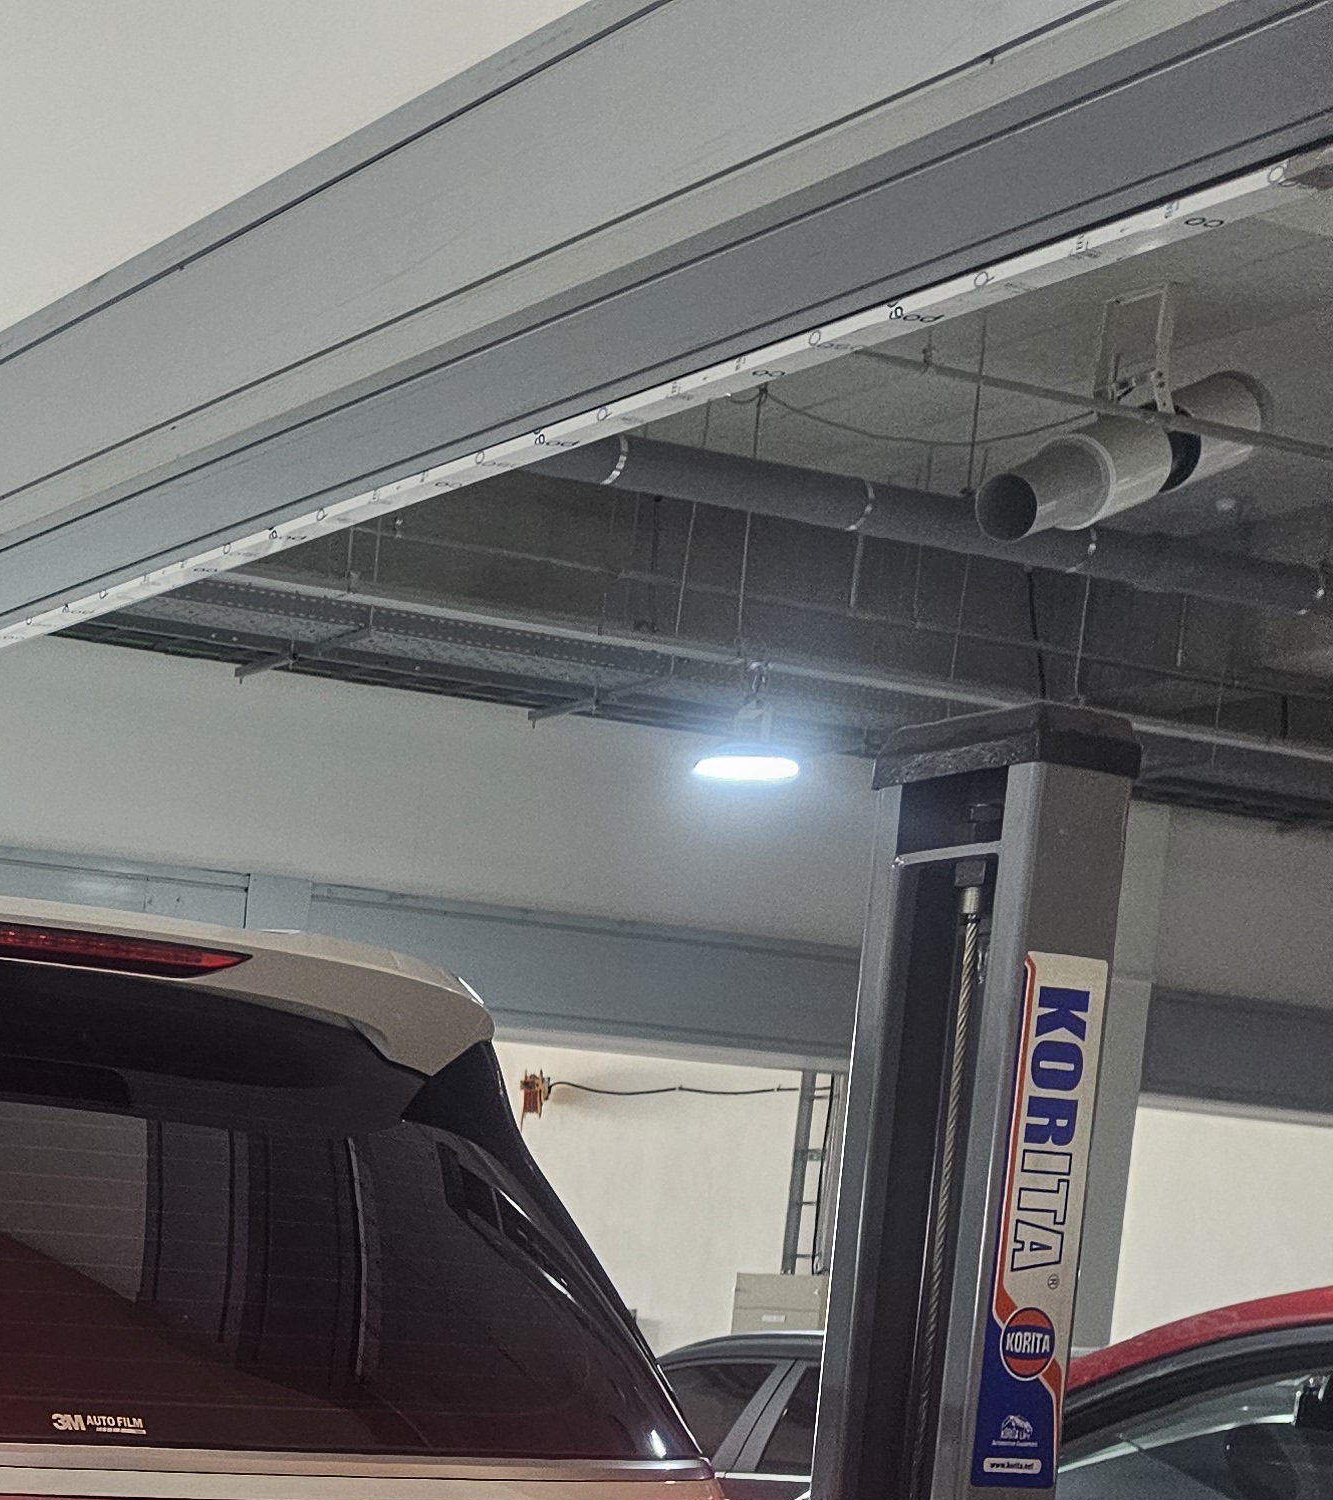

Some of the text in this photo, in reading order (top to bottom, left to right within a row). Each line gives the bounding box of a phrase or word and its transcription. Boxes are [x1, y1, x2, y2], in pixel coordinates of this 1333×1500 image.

[1005, 1331, 1050, 1353] KORITA
[51, 1413, 86, 1431] 3M
[86, 1415, 115, 1426] AUTO
[116, 1416, 144, 1428] FILM
[990, 1461, 1034, 1470] www.korita.net
